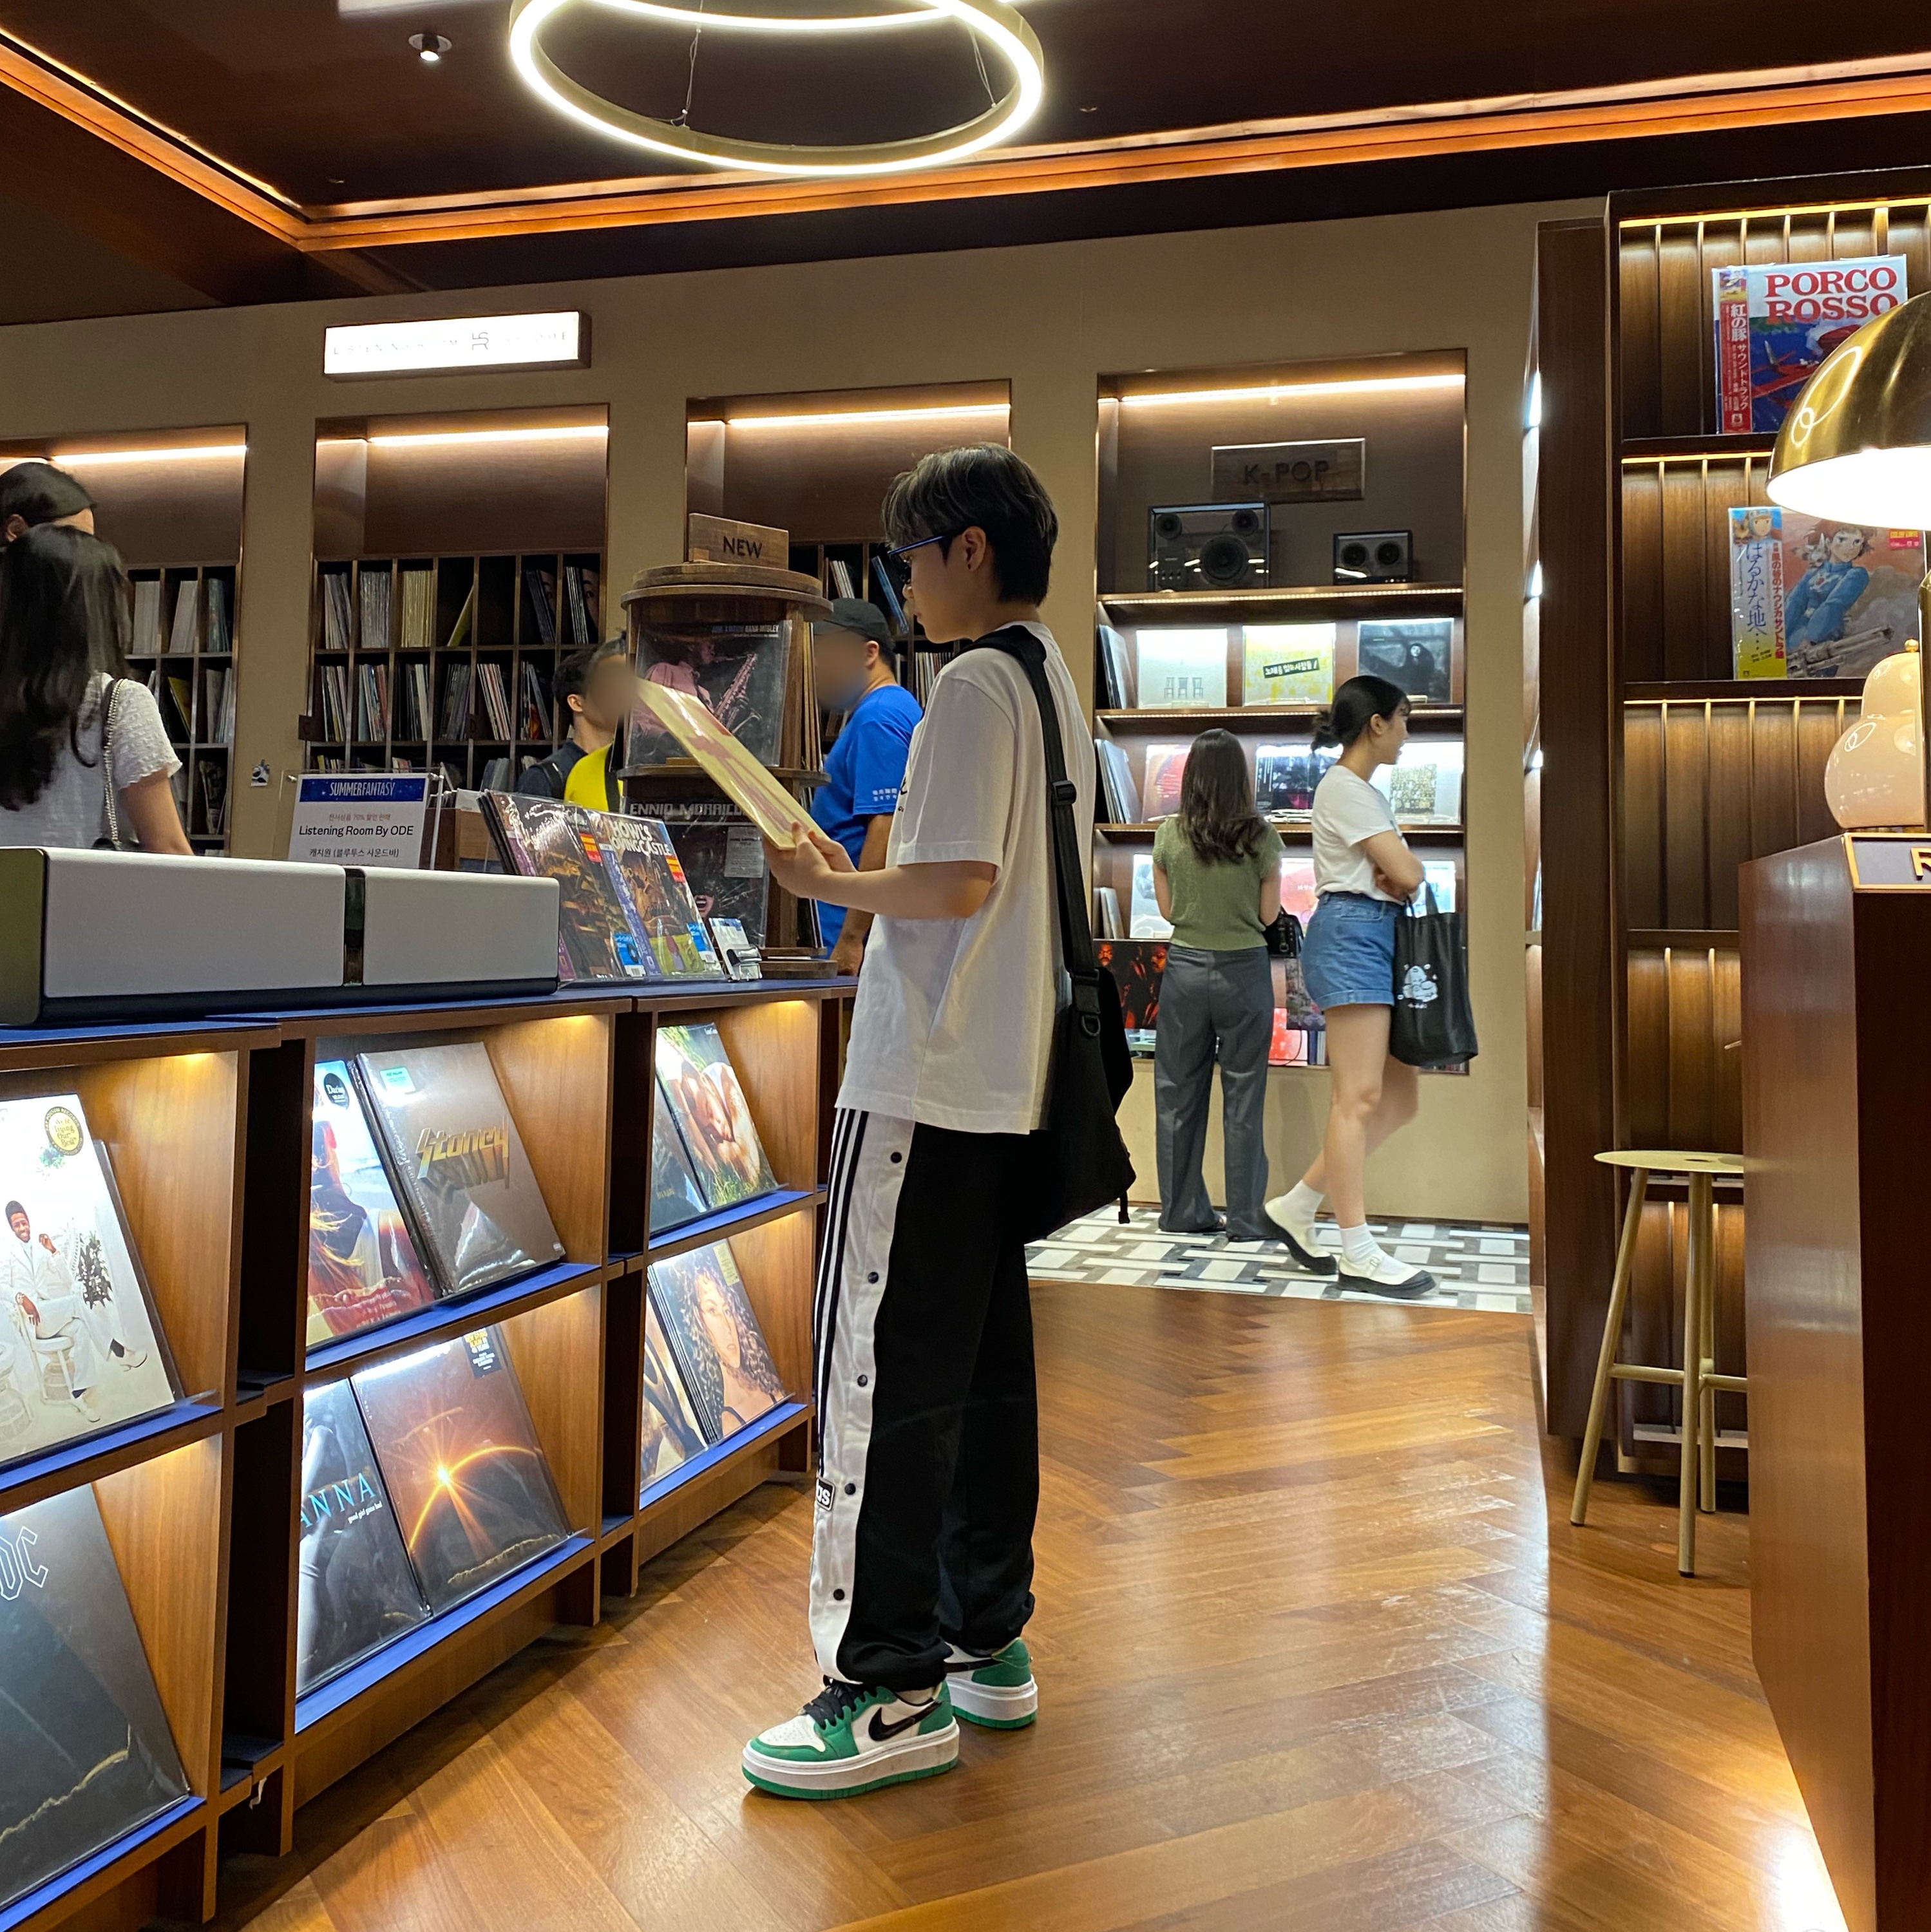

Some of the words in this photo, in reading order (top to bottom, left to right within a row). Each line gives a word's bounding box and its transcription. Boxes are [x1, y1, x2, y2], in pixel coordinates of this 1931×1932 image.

[1764, 267, 1898, 298] PORCO
[1767, 293, 1899, 323] ROSSO
[1731, 303, 1747, 341] 紅の豚
[1737, 343, 1749, 410] サウンドトラック
[1243, 460, 1329, 485] K-POP
[723, 535, 763, 558] NEW
[629, 802, 674, 816] ENNIO
[680, 802, 747, 817] MORRICO
[299, 825, 345, 837] Listening
[345, 826, 374, 835] Room
[375, 826, 388, 837] By
[390, 825, 414, 835] ODE
[609, 820, 653, 842] HOWL'S
[309, 848, 331, 858] 캐치원
[333, 848, 365, 858] (블루투스
[366, 848, 399, 858] 사운드바)
[415, 1115, 509, 1180] Stoney
